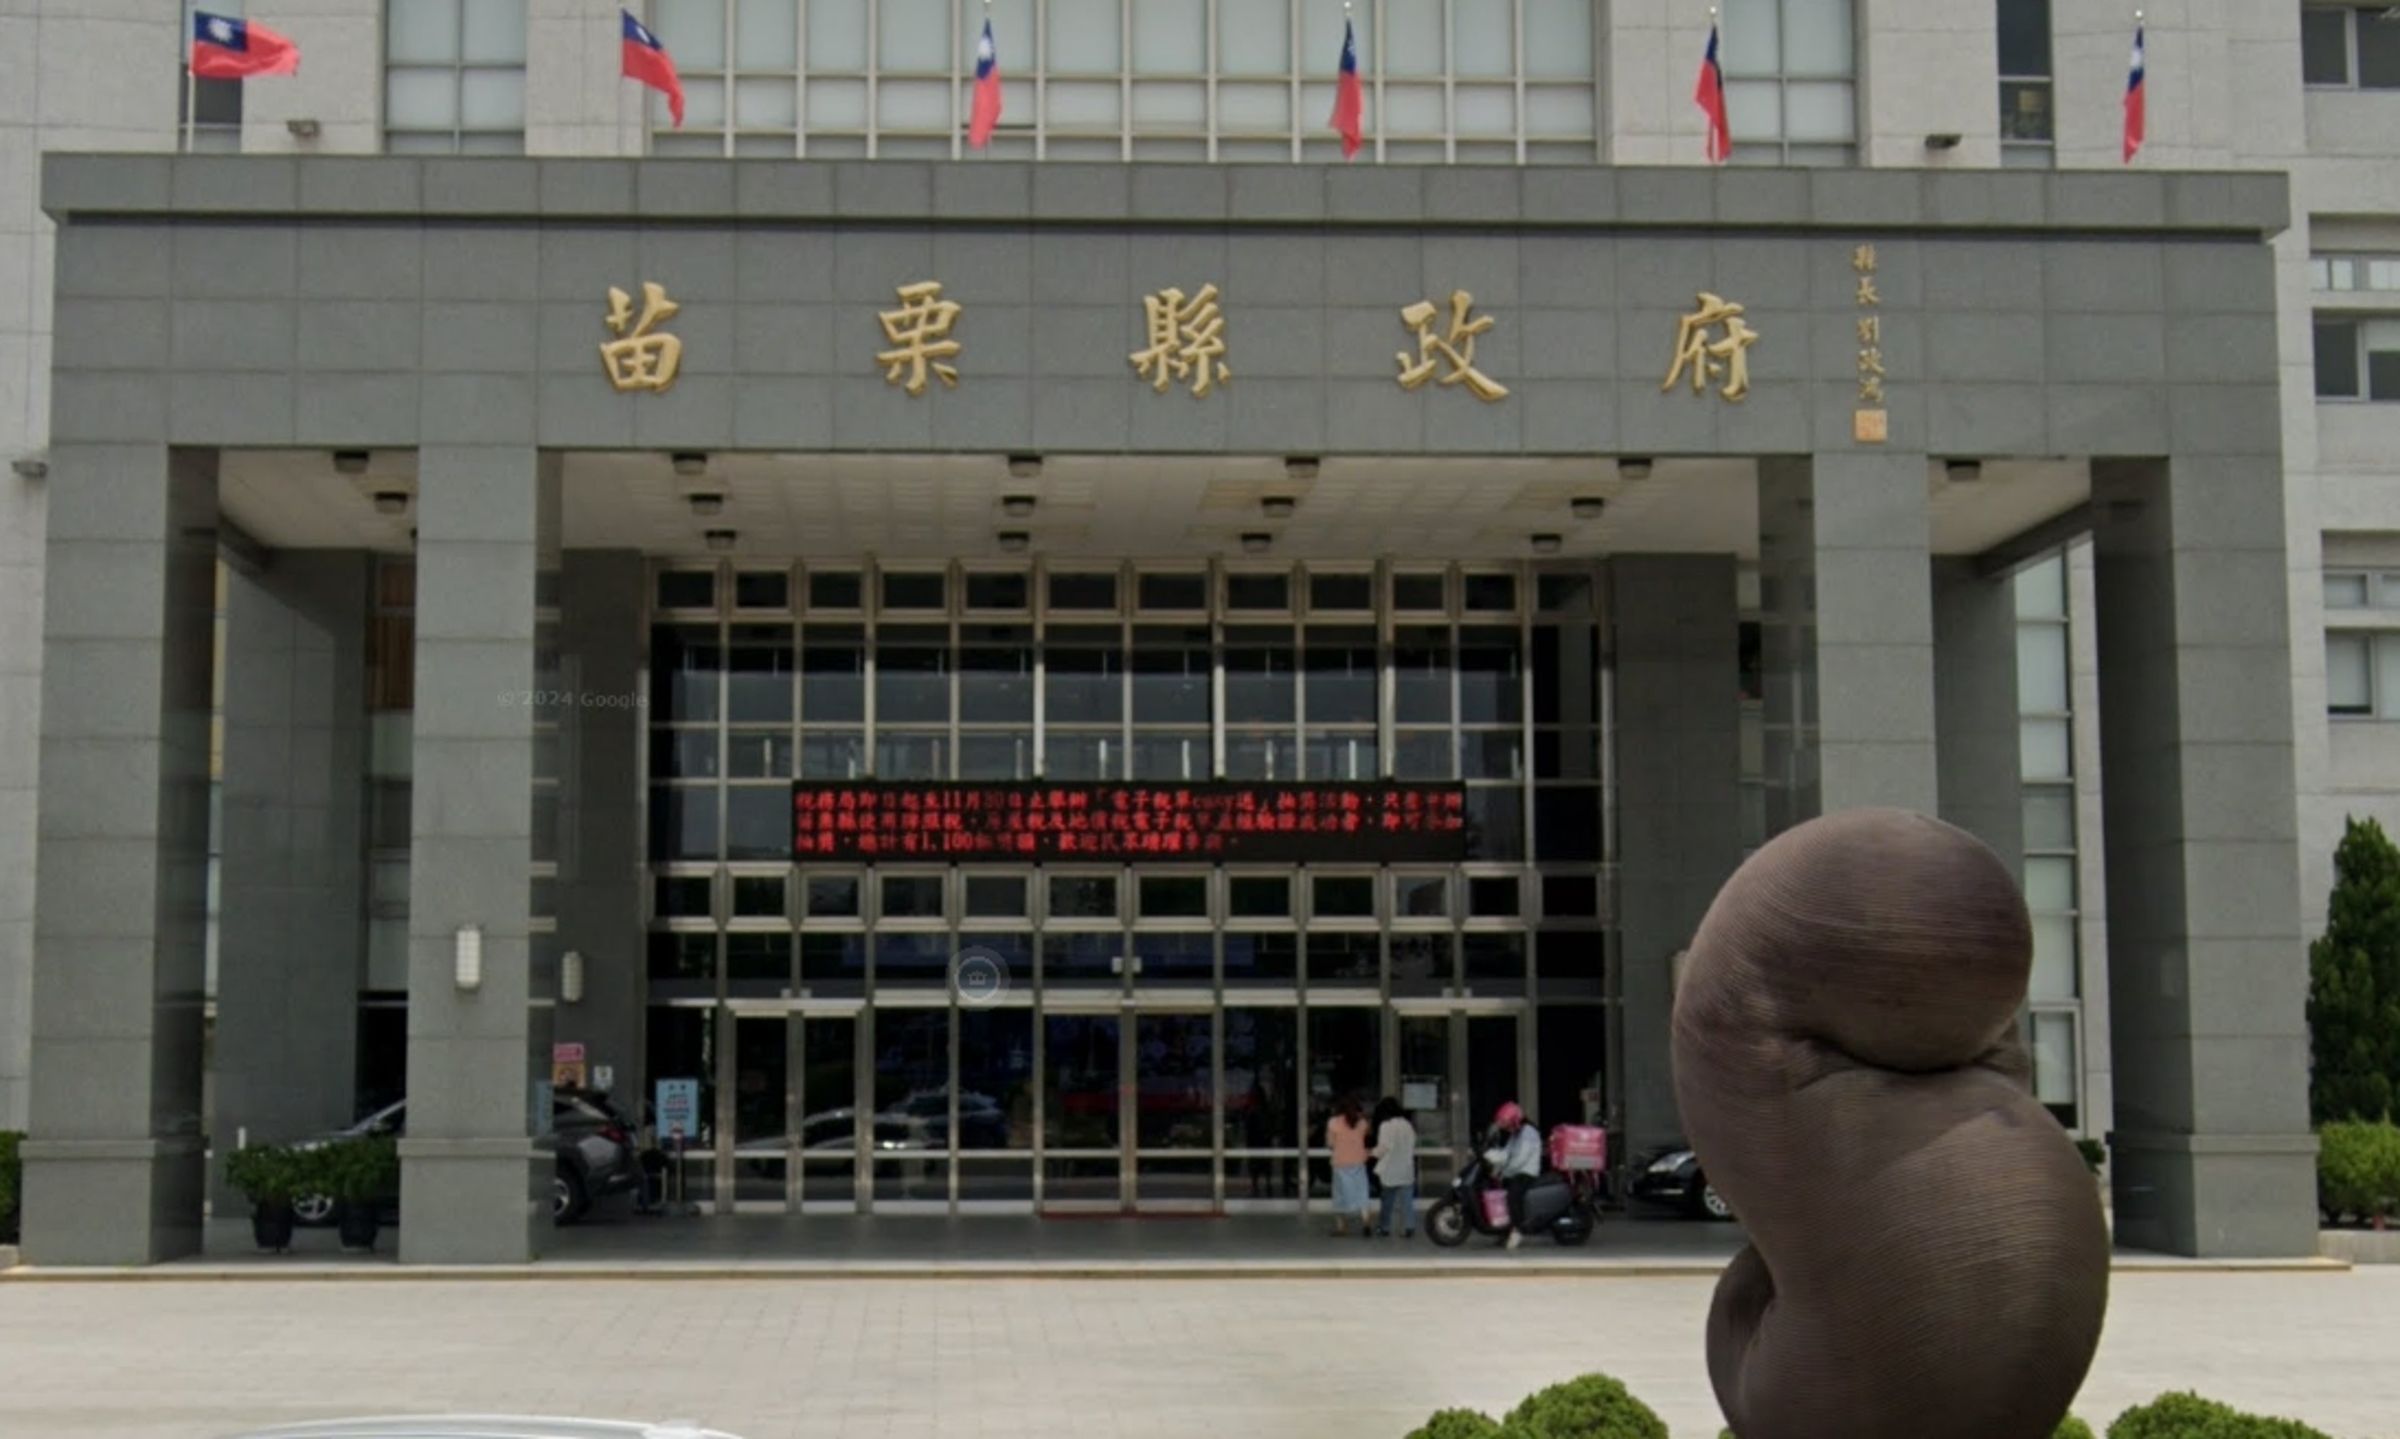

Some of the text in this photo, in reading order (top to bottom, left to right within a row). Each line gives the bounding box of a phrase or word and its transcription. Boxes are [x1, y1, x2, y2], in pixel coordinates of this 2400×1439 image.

[599, 281, 1760, 404] 苗栗縣政府
